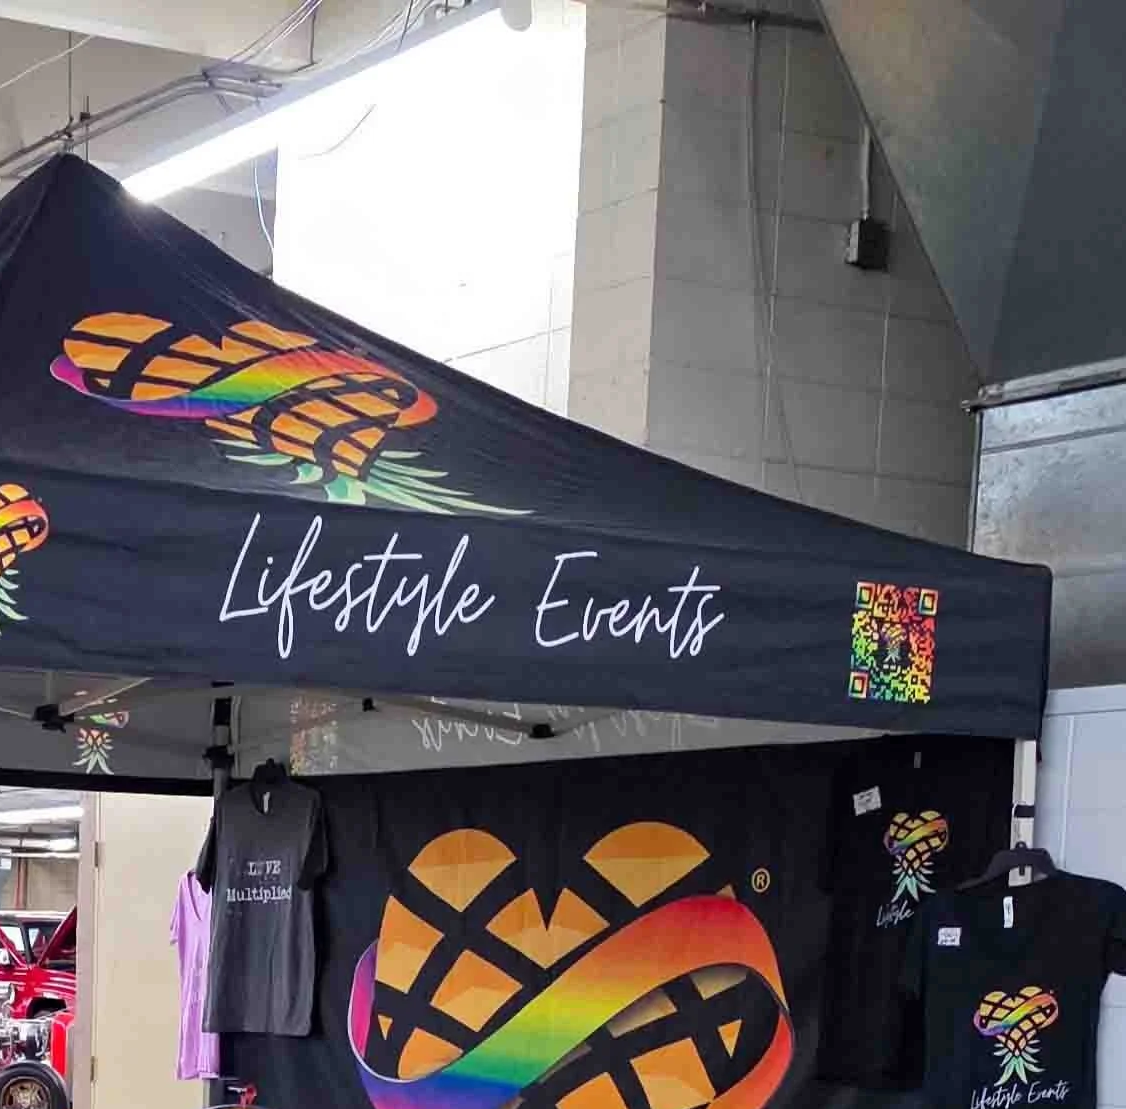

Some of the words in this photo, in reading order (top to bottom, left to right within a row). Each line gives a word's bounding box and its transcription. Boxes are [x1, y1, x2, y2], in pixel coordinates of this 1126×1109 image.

[219, 512, 496, 659] Lifestyle
[533, 550, 725, 659] Events
[225, 885, 292, 904] Multiplied
[1027, 1079, 1071, 1104] Events
